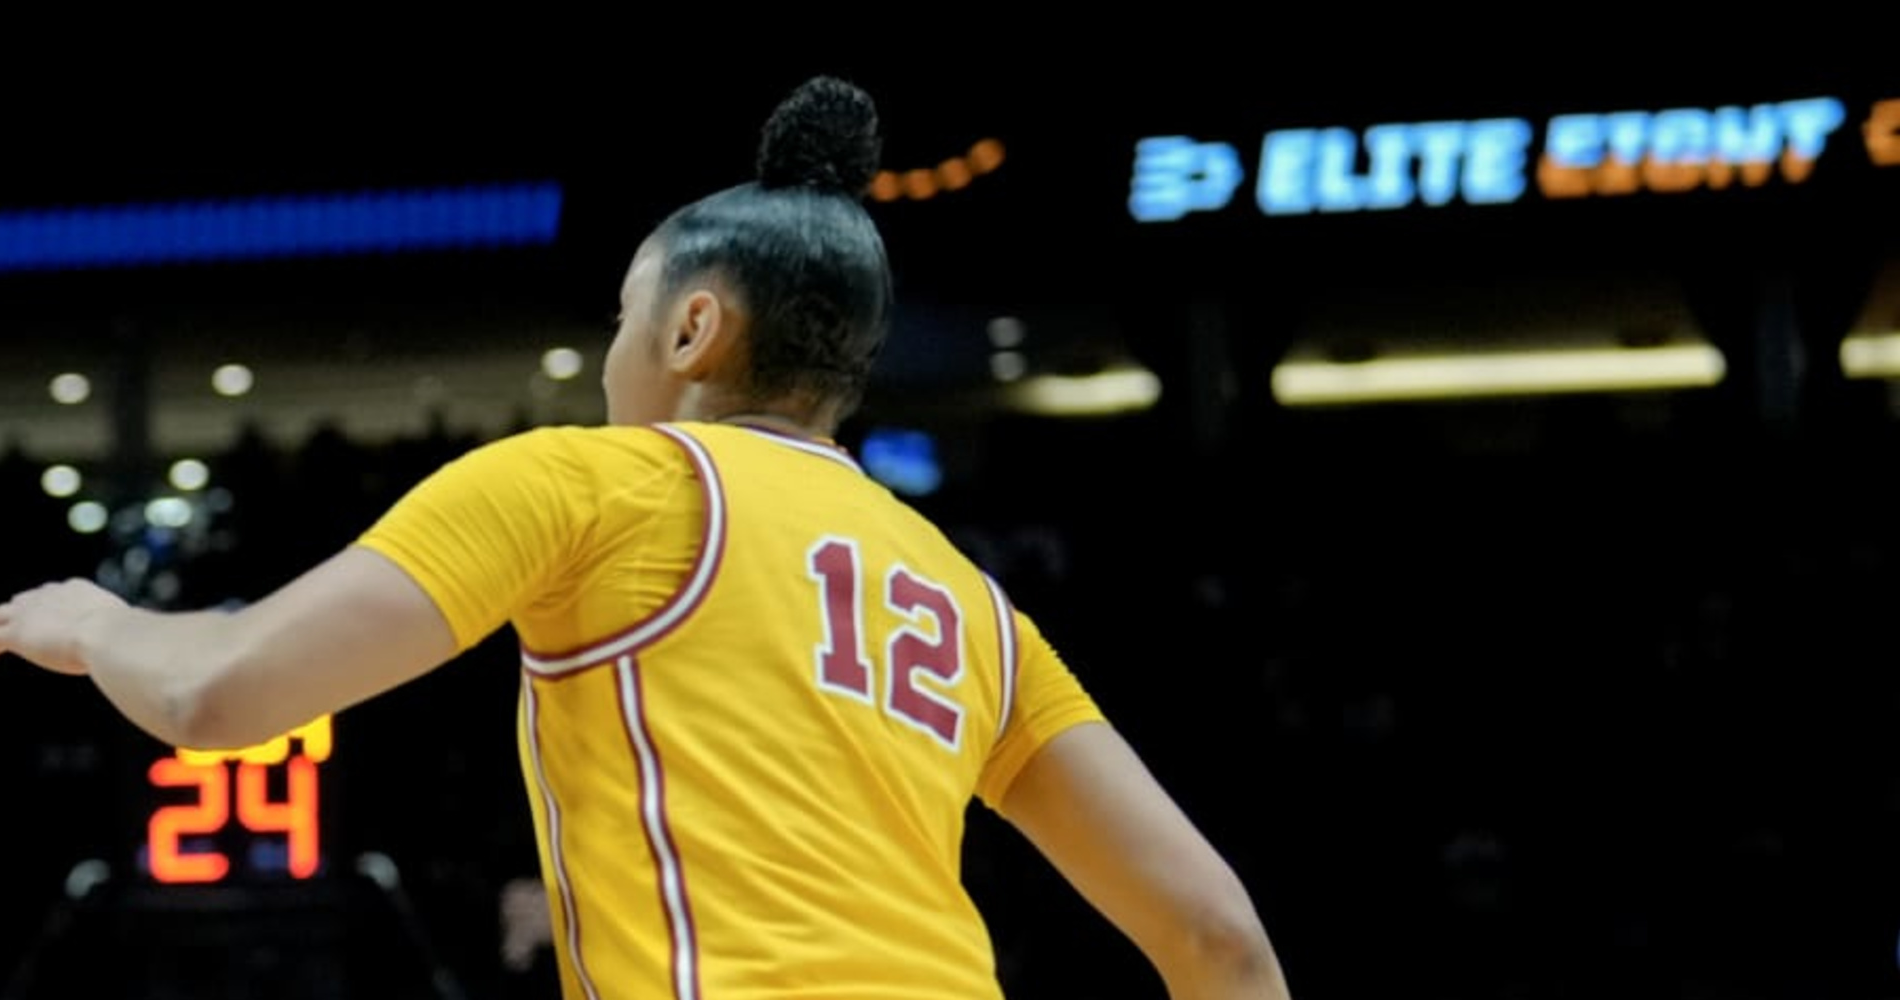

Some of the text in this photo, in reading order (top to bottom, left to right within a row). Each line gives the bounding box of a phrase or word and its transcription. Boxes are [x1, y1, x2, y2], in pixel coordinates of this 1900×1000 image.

[1255, 116, 1533, 217] ELITE
[804, 533, 966, 755] 12
[145, 752, 320, 885] 24
